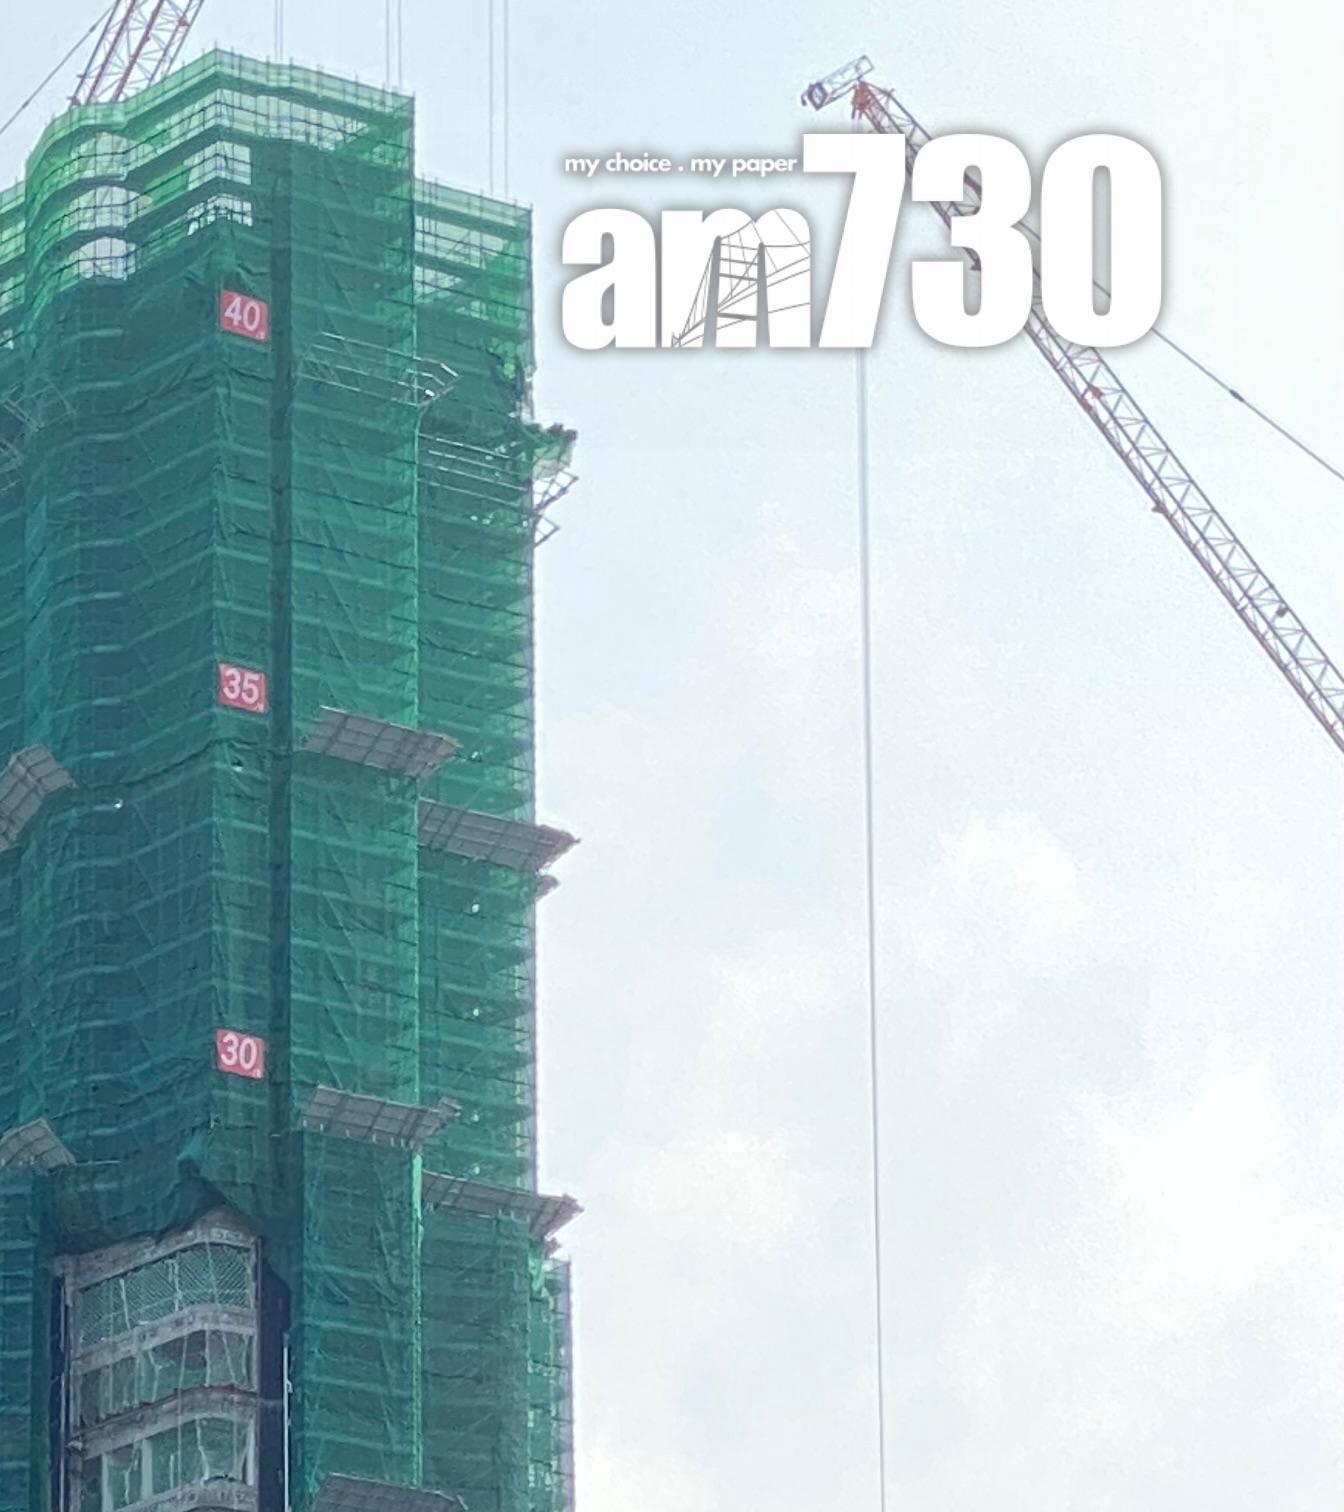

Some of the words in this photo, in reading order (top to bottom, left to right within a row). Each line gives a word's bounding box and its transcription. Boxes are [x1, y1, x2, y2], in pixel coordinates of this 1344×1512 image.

[224, 296, 261, 331] 40
[223, 667, 260, 704] 35
[220, 1031, 258, 1070] 30
